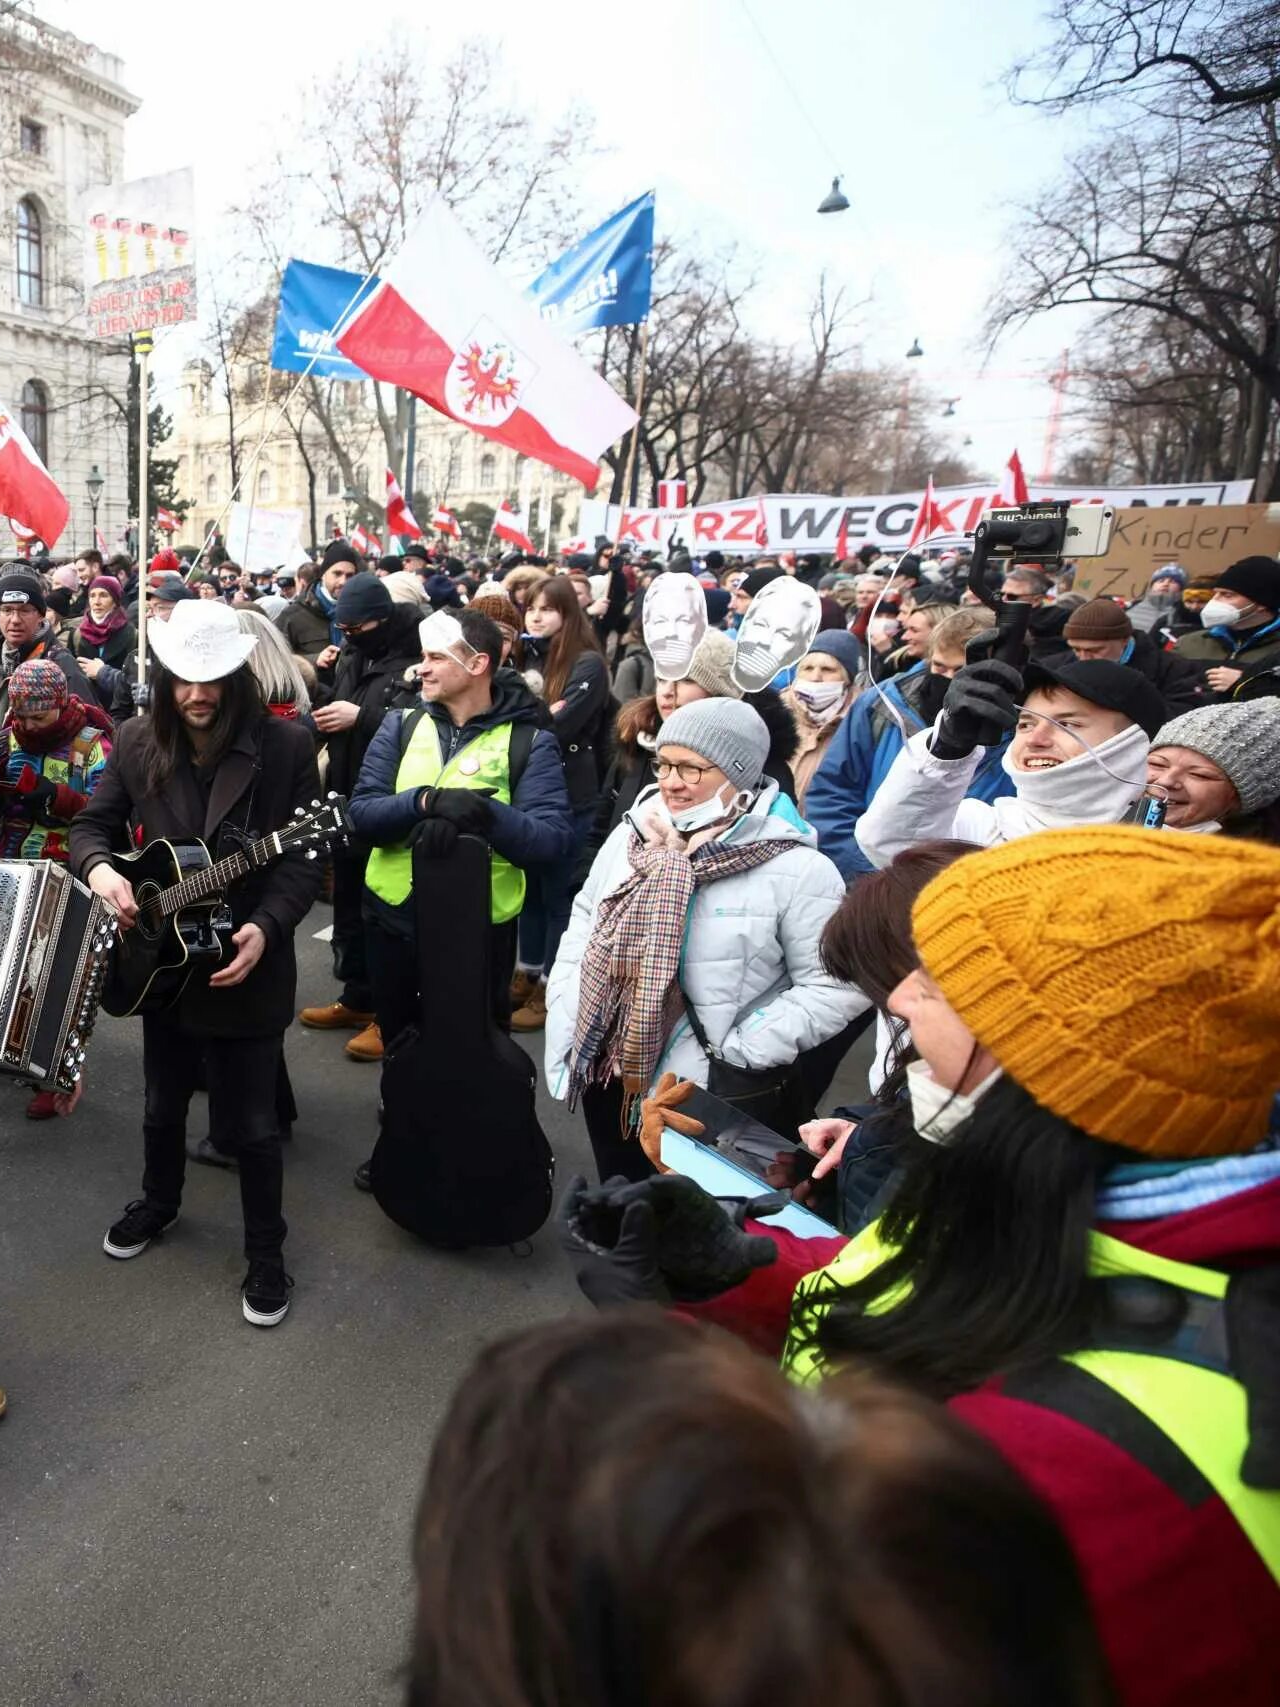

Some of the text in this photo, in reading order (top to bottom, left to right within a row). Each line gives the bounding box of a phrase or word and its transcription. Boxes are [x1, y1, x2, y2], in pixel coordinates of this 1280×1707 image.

[620, 509, 759, 542] KRZ
[780, 502, 919, 540] WEG
[1111, 513, 1249, 550] Kinder
